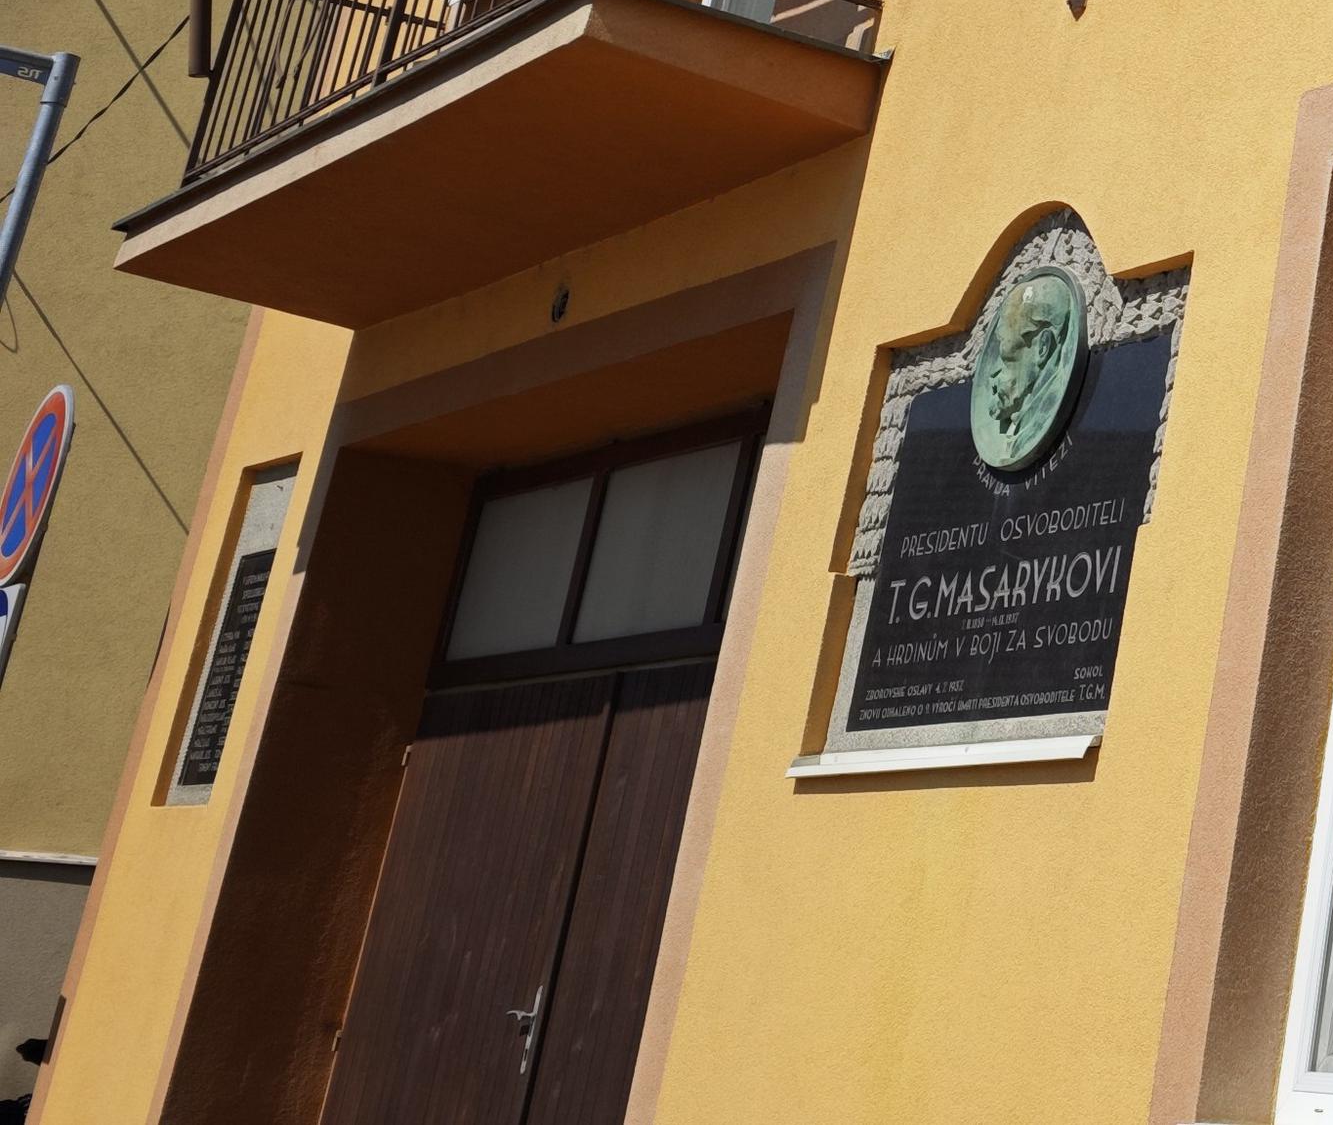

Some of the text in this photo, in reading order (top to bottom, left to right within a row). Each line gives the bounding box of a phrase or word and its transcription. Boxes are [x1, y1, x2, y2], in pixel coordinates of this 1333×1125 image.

[899, 498, 1125, 559] PRESIDENTU OSVOBODITELI
[872, 618, 1114, 668] A HRDINŮM V BOJI ZA SVOBODU
[1073, 664, 1104, 680] SOKOL
